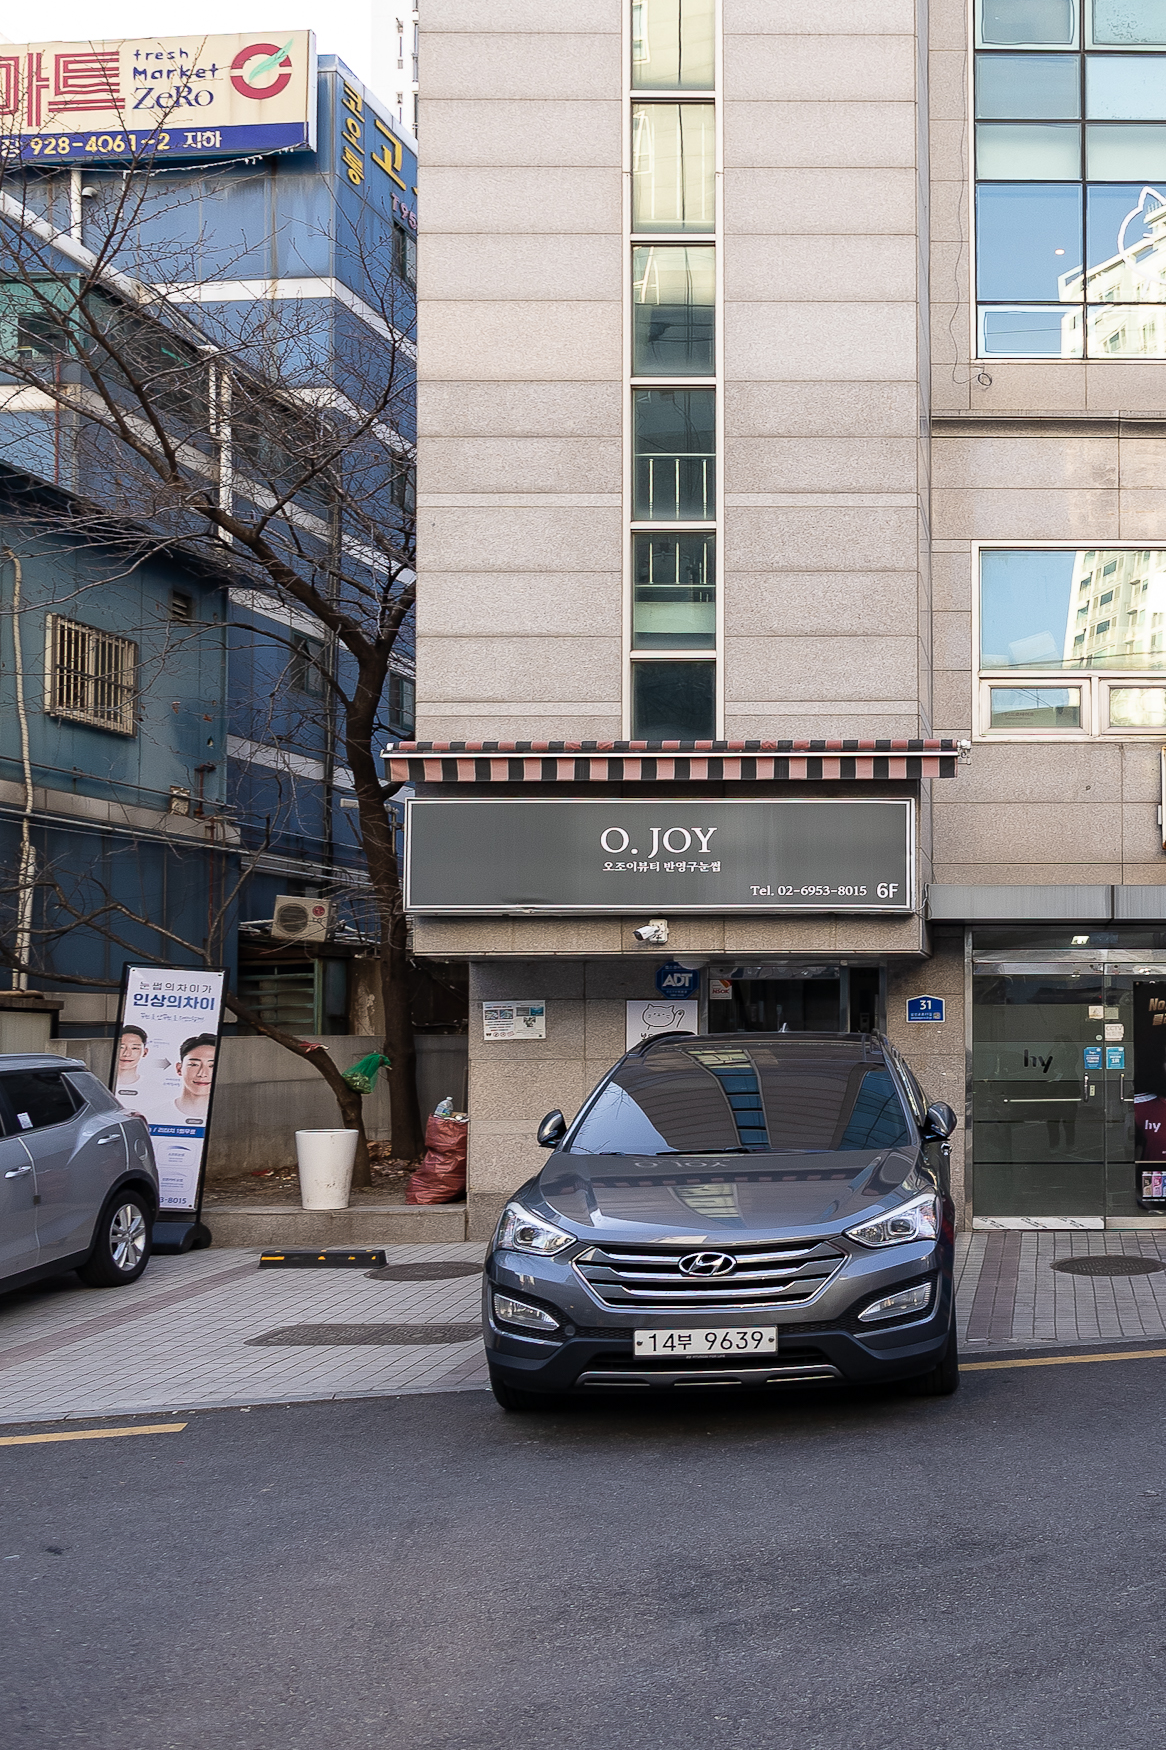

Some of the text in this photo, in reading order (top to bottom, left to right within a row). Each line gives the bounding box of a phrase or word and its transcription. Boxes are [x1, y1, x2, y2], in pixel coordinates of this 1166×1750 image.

[133, 48, 188, 61] fresh
[133, 63, 218, 81] Market
[132, 85, 214, 109] ZeRo
[30, 133, 170, 155] 928-4061-2
[183, 131, 222, 149] 지하
[600, 827, 718, 859] O. JOY
[602, 861, 721, 872] 오조이뷰티 반영구눈썹
[750, 882, 899, 898] Tel. 02-6953-8015 6F
[662, 973, 693, 987] ADT
[919, 1000, 932, 1010] 31
[1024, 1049, 1053, 1073] hy
[1144, 1119, 1162, 1133] hy
[648, 1330, 764, 1352] 14부 9639
